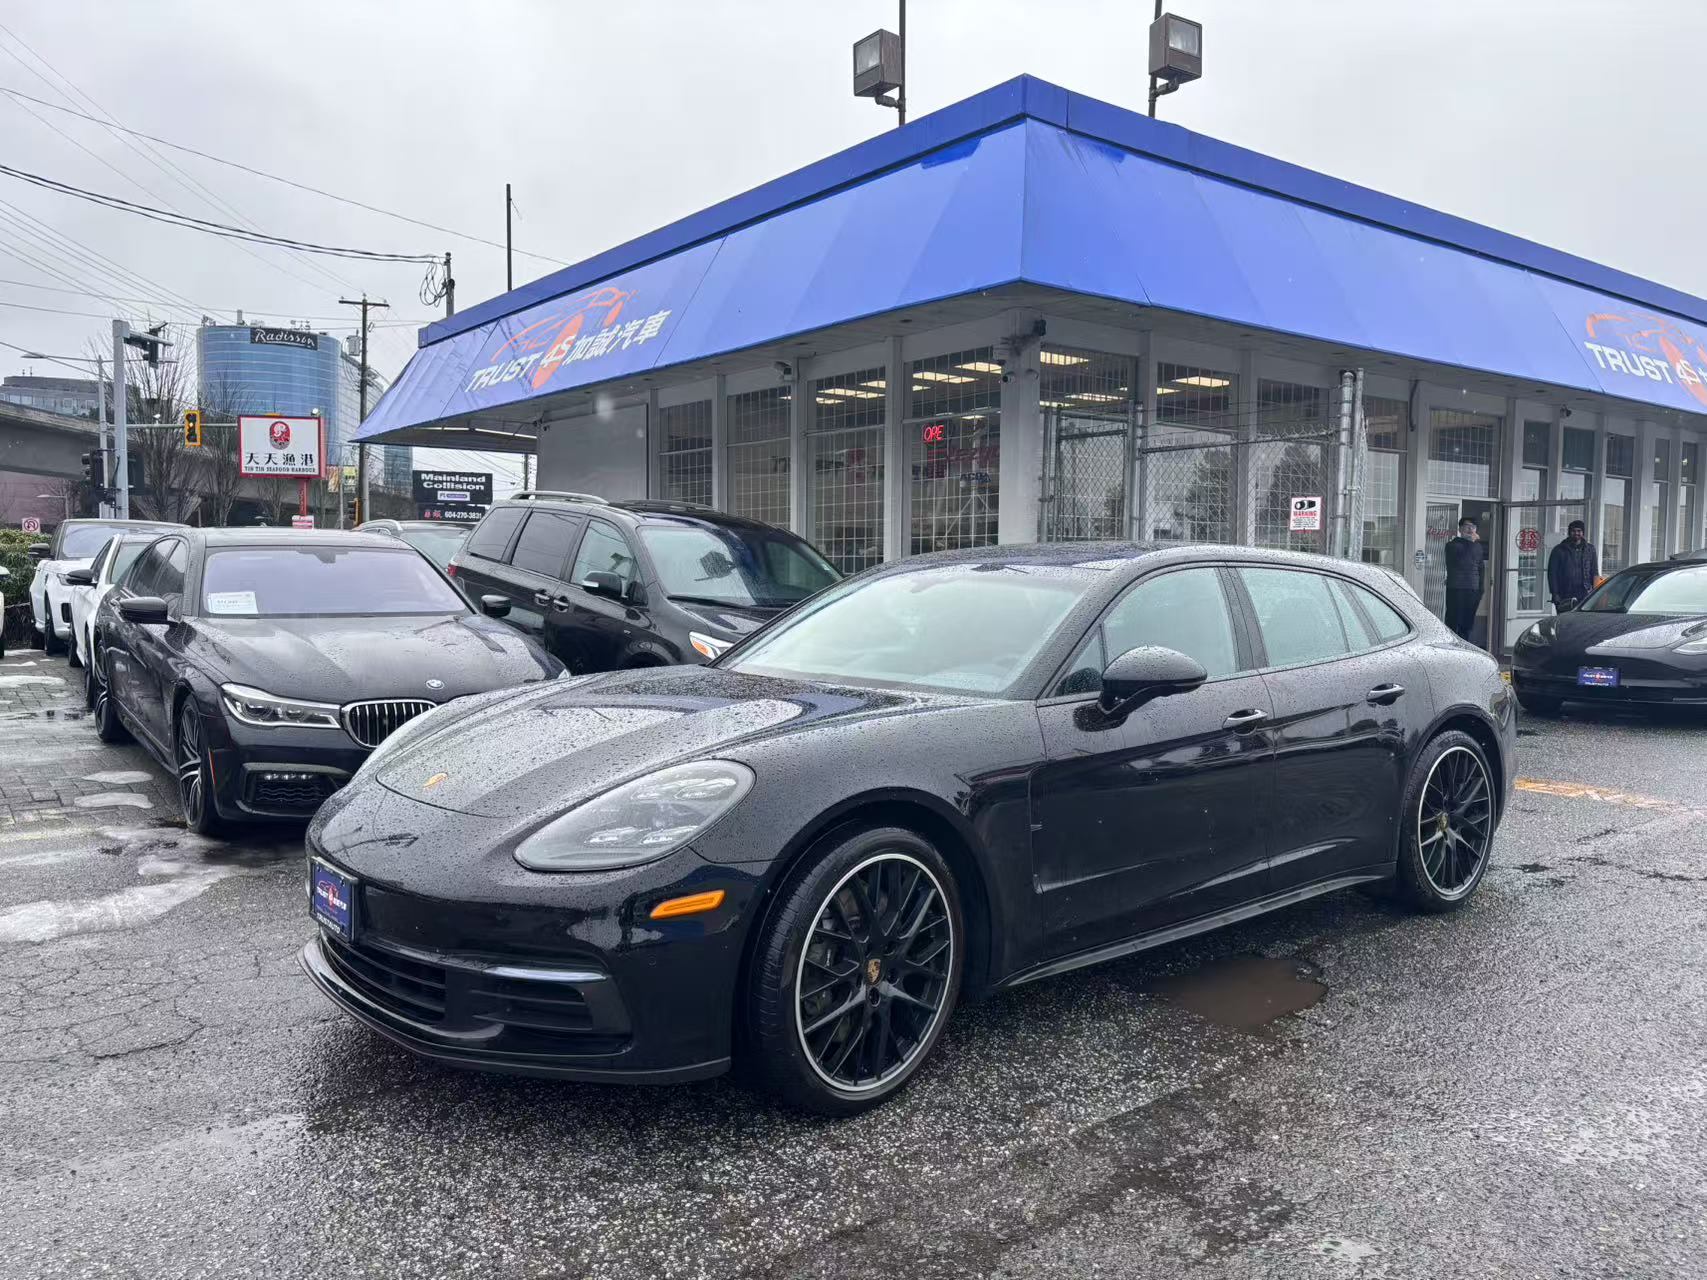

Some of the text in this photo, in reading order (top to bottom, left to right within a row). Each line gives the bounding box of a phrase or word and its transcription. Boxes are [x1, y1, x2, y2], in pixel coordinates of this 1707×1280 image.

[255, 328, 315, 347] Radisson
[465, 351, 544, 392] TRUST
[1584, 341, 1674, 384] TRUST
[421, 473, 486, 482] Mainland
[422, 481, 485, 490] Collision
